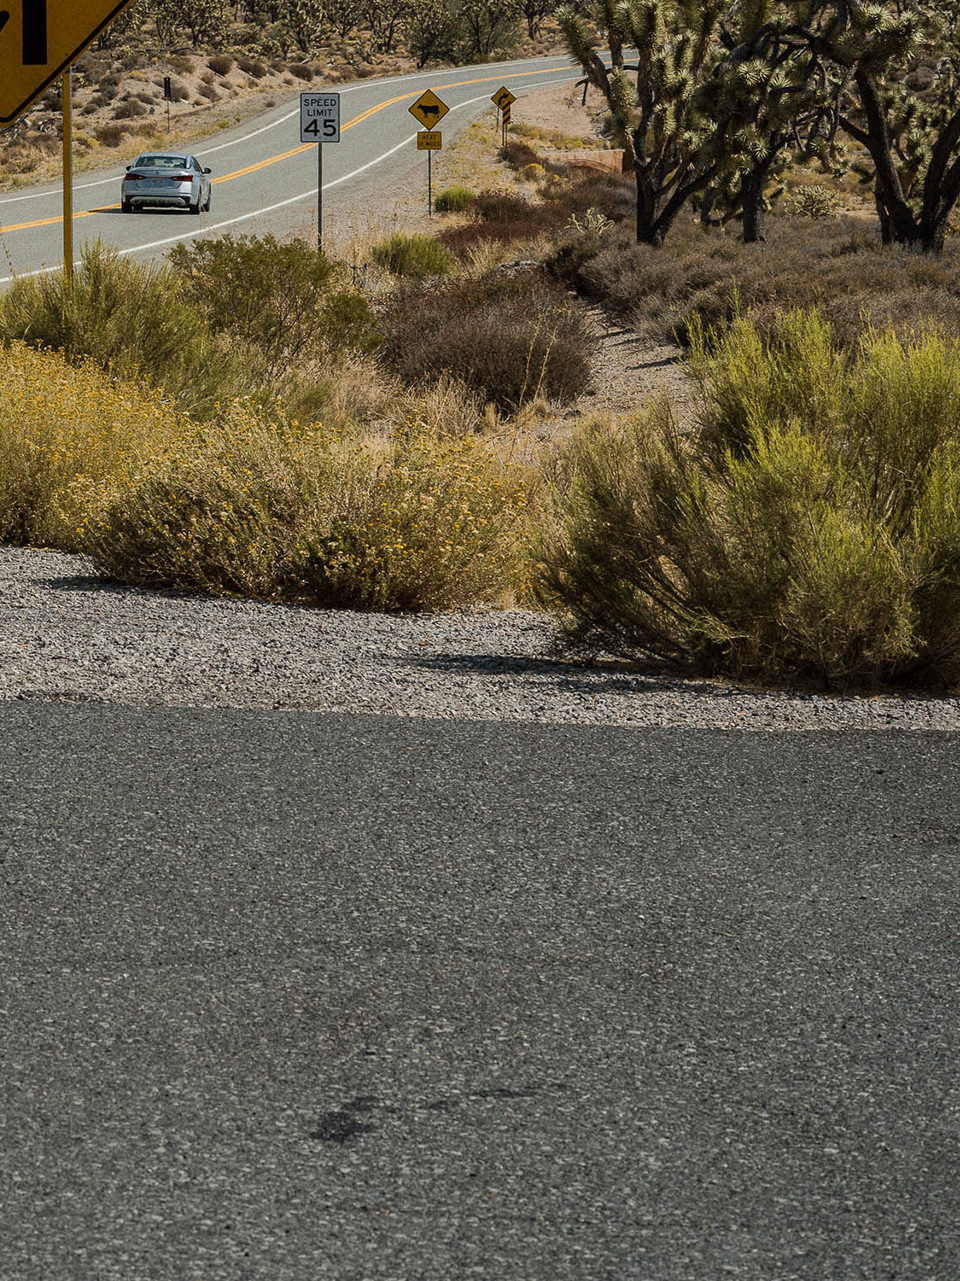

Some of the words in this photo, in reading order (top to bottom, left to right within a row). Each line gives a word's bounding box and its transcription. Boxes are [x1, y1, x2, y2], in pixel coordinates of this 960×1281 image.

[303, 98, 337, 107] SPEED
[307, 108, 333, 117] LIMIT
[303, 118, 337, 137] 45
